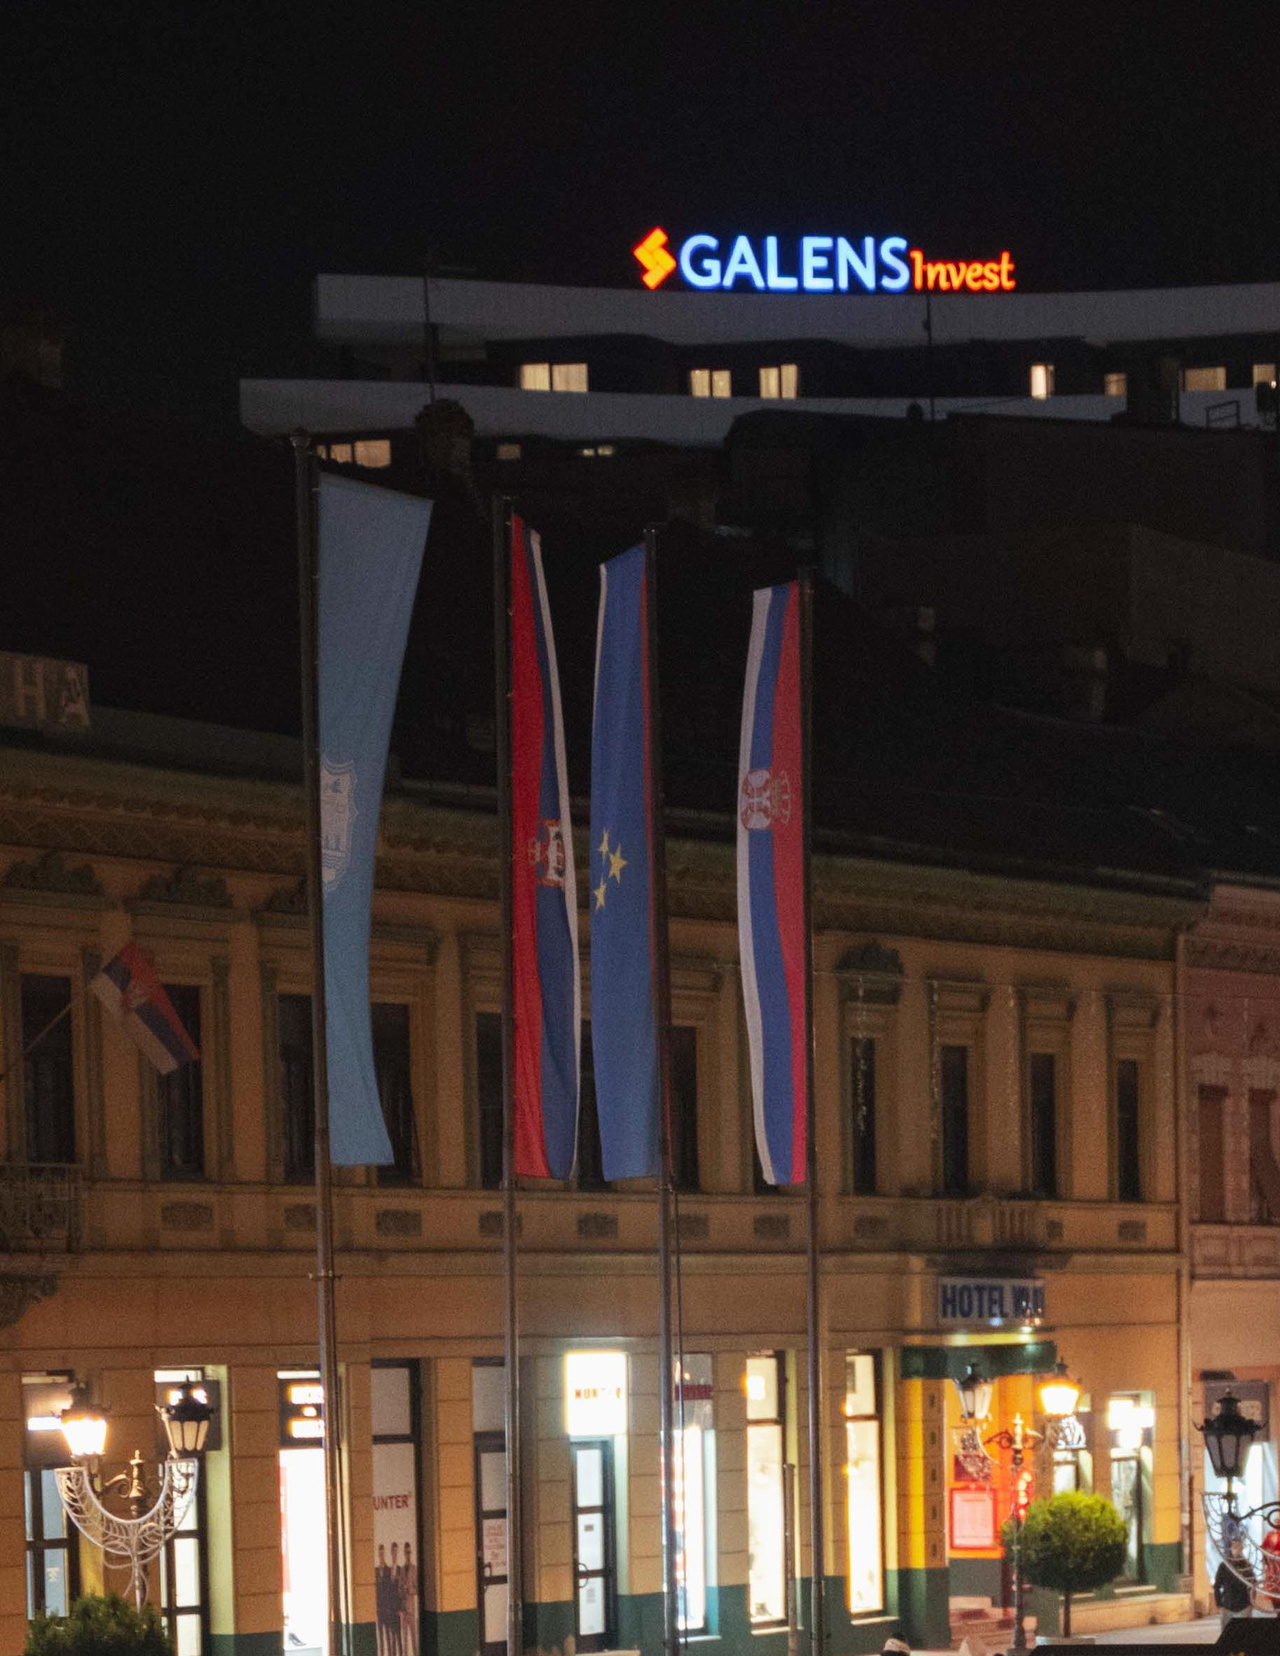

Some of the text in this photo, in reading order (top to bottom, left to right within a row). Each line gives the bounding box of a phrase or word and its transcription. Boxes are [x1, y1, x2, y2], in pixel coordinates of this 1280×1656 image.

[679, 234, 1016, 291] GALENS Invest
[941, 1284, 1008, 1318] HOTEL
